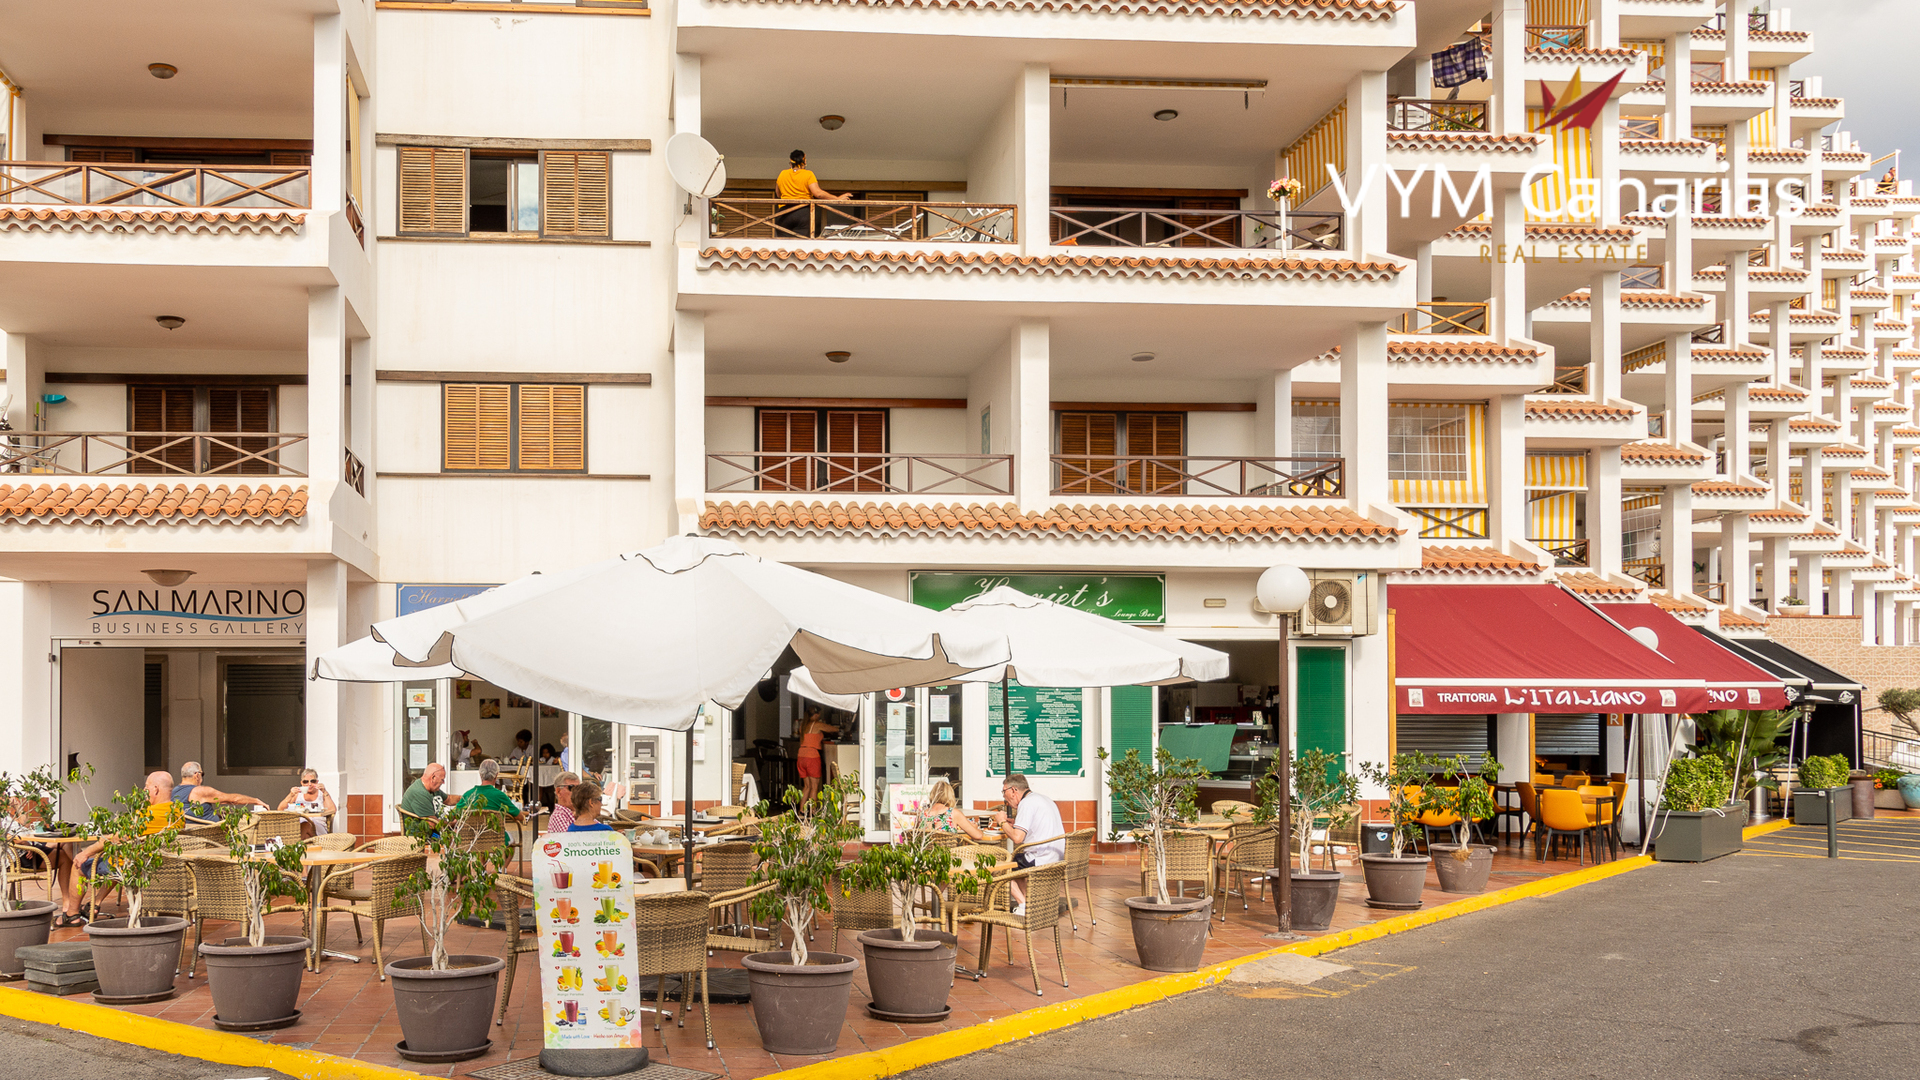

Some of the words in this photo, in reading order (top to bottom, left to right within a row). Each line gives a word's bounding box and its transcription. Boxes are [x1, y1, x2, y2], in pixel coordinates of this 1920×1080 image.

[92, 589, 159, 616] SAN
[171, 589, 305, 615] MARINO
[1111, 608, 1137, 620] Lounge
[1138, 608, 1156, 618] Bar
[92, 622, 198, 634] BUSINESS
[209, 622, 304, 634] GALLERY
[1437, 692, 1498, 703] TRATTORIA
[1504, 687, 1647, 707] L'ITALIANO
[563, 846, 621, 858] Smoothies
